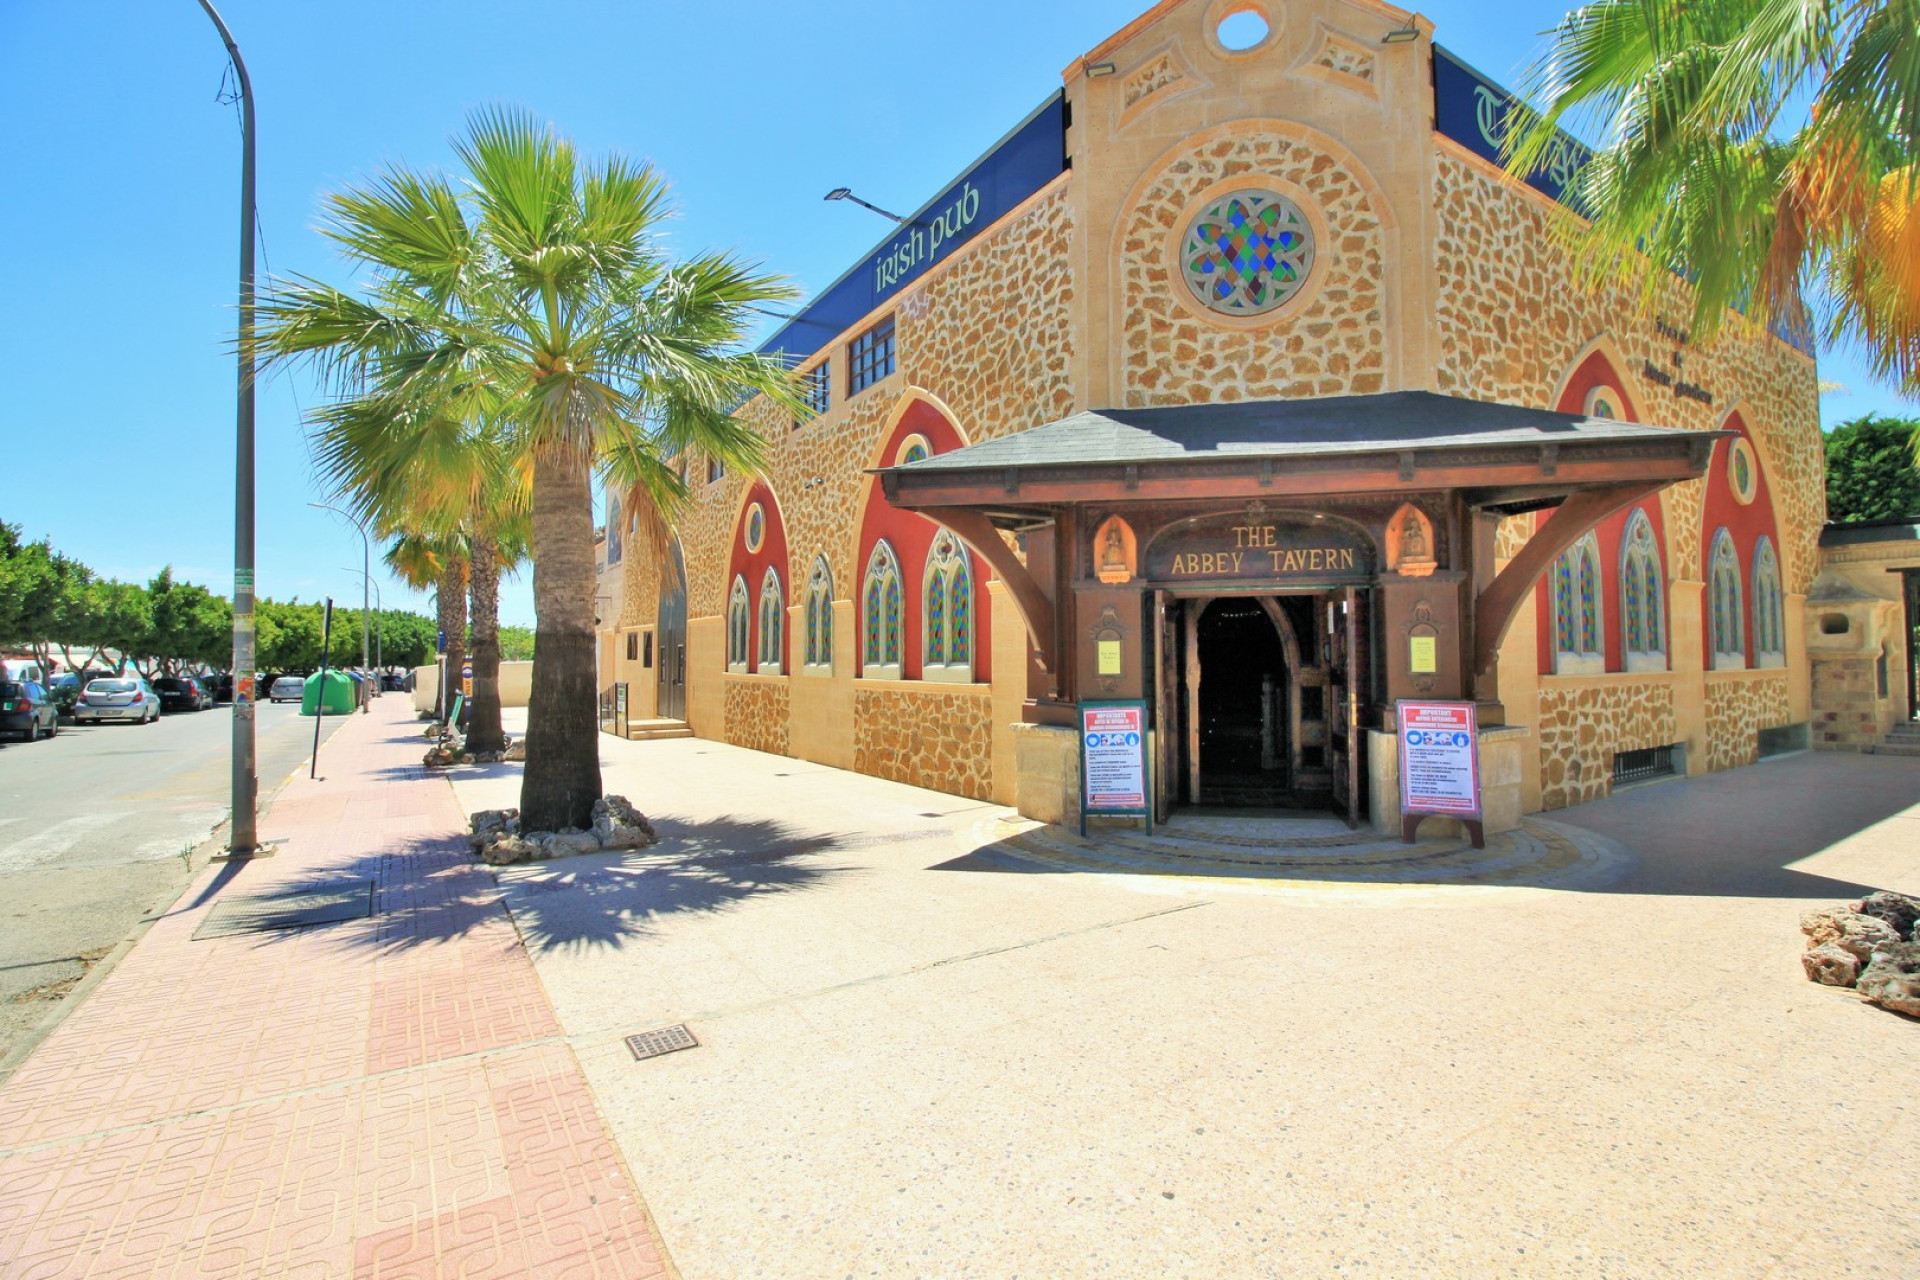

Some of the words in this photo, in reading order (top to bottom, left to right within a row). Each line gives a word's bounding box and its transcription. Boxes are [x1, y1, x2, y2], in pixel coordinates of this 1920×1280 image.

[929, 181, 980, 262] pub
[1231, 525, 1277, 548] THE
[1171, 552, 1244, 575] ABBEY
[1267, 549, 1355, 572] TAVERN
